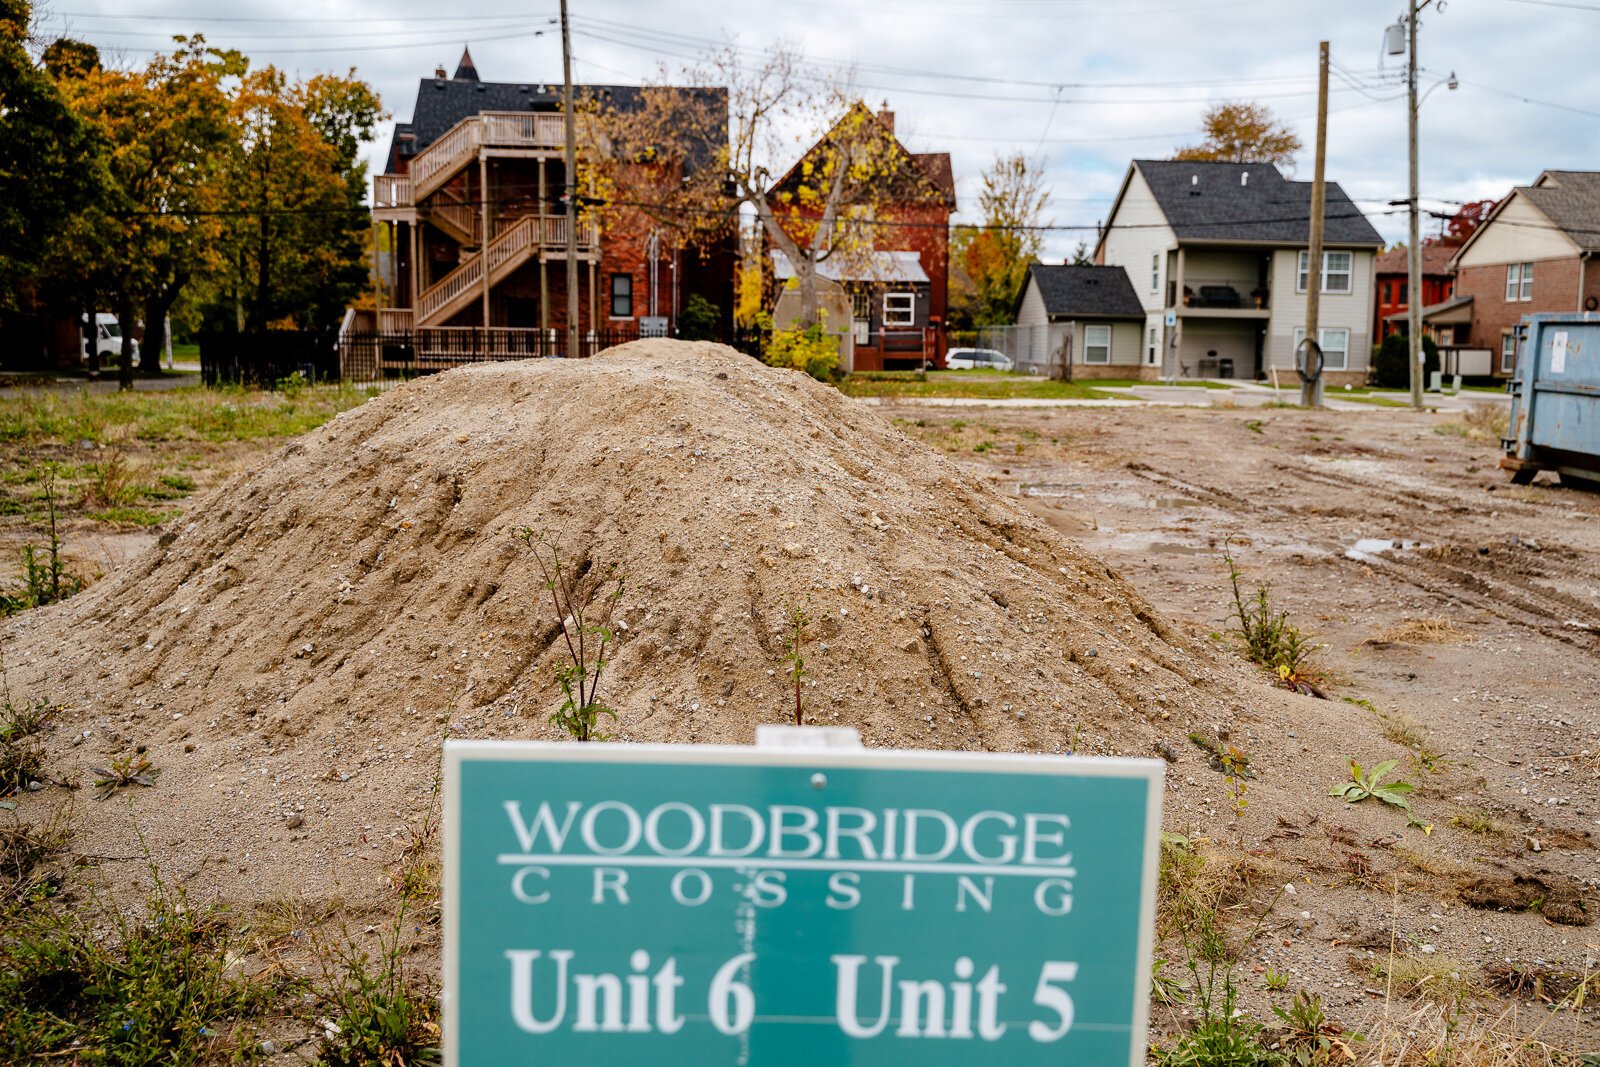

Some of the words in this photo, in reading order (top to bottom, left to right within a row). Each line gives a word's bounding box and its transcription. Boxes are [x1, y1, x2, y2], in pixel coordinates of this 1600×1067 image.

[503, 800, 1074, 866] WOODBRIDGE
[510, 866, 1075, 916] CROSSING
[505, 948, 685, 1034] Unit
[708, 952, 757, 1036] 6
[831, 953, 1007, 1040] Unit
[1027, 960, 1079, 1042] 5
